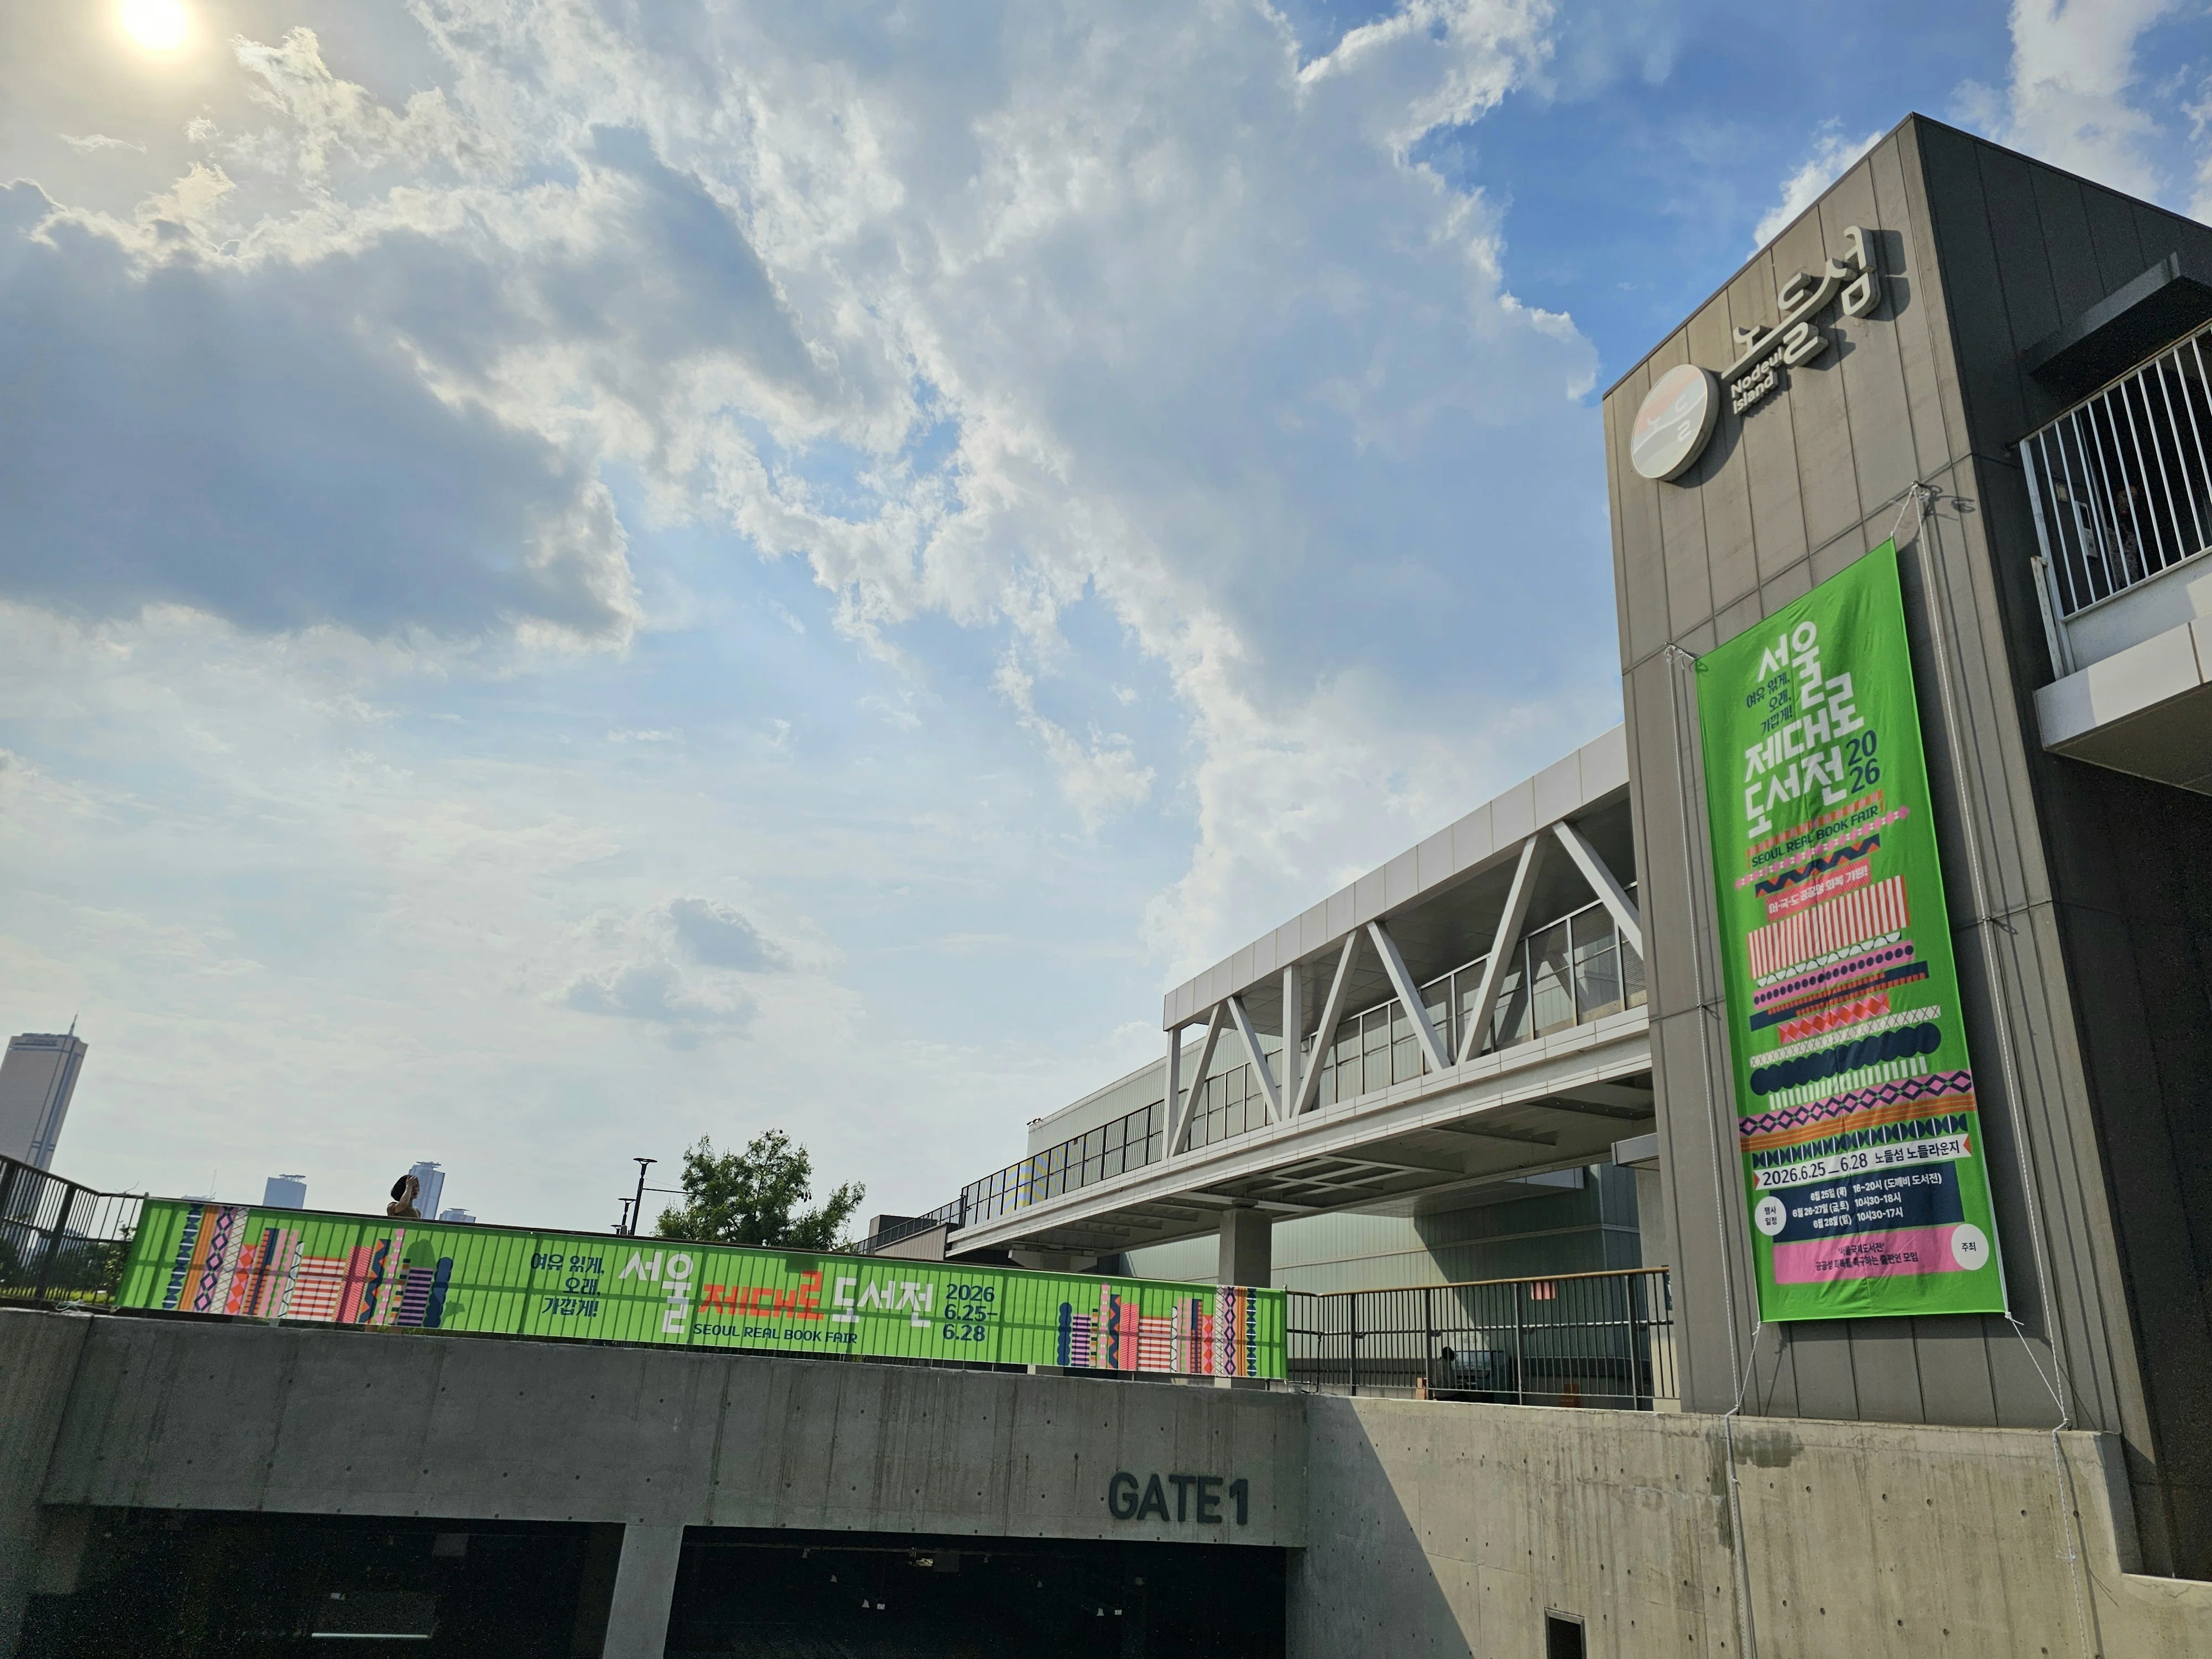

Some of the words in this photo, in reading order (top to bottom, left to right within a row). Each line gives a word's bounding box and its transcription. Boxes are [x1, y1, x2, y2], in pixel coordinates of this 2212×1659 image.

[1731, 347, 1783, 398] Nodeul
[1733, 371, 1774, 415] Island
[1757, 621, 1824, 710] 서울
[1746, 687, 1765, 708] 여유
[1745, 672, 1864, 783] 제대로
[1761, 705, 1793, 736] 가깝게!
[1846, 729, 1877, 766] 20
[1850, 758, 1880, 795] 26
[1745, 745, 1847, 839] 도서전
[1752, 847, 1786, 867] SEOUL
[1786, 834, 1813, 853] REAL
[1816, 818, 1848, 840] BOOK
[1851, 805, 1878, 826] FAIR
[1875, 1147, 1905, 1164] 노들섬
[1907, 1140, 1960, 1160] 노들라운지
[1811, 1191, 1820, 1201] 6월
[1822, 1188, 1835, 1199] 25일
[1853, 1180, 1882, 1193] 16~20시
[1912, 1173, 1942, 1185] 도서전)
[1764, 1206, 1777, 1215] 행사
[1792, 1208, 1804, 1218] 6월
[1855, 1192, 1902, 1207] 10시30-18시
[1765, 1217, 1777, 1225] 일정
[1813, 1218, 1824, 1229] 6월
[1824, 1215, 1838, 1227] 28일
[1857, 1207, 1903, 1222] 10시30-17시
[1903, 1251, 1918, 1262] 모임
[1961, 1241, 1976, 1251] 주최
[530, 1253, 564, 1271] 여유
[569, 1255, 604, 1275] 있게,
[563, 1277, 601, 1297] 오래,
[618, 1250, 693, 1333] 서울
[697, 1270, 824, 1321] 제대로
[832, 1277, 933, 1328] 도서전
[946, 1284, 995, 1302] 2026
[542, 1297, 599, 1317] 가깝게!
[693, 1323, 740, 1337] SEOUL
[743, 1327, 780, 1339] REAL
[784, 1329, 822, 1342] BOOK
[825, 1332, 858, 1344] FAIR
[942, 1323, 986, 1342] 6.28
